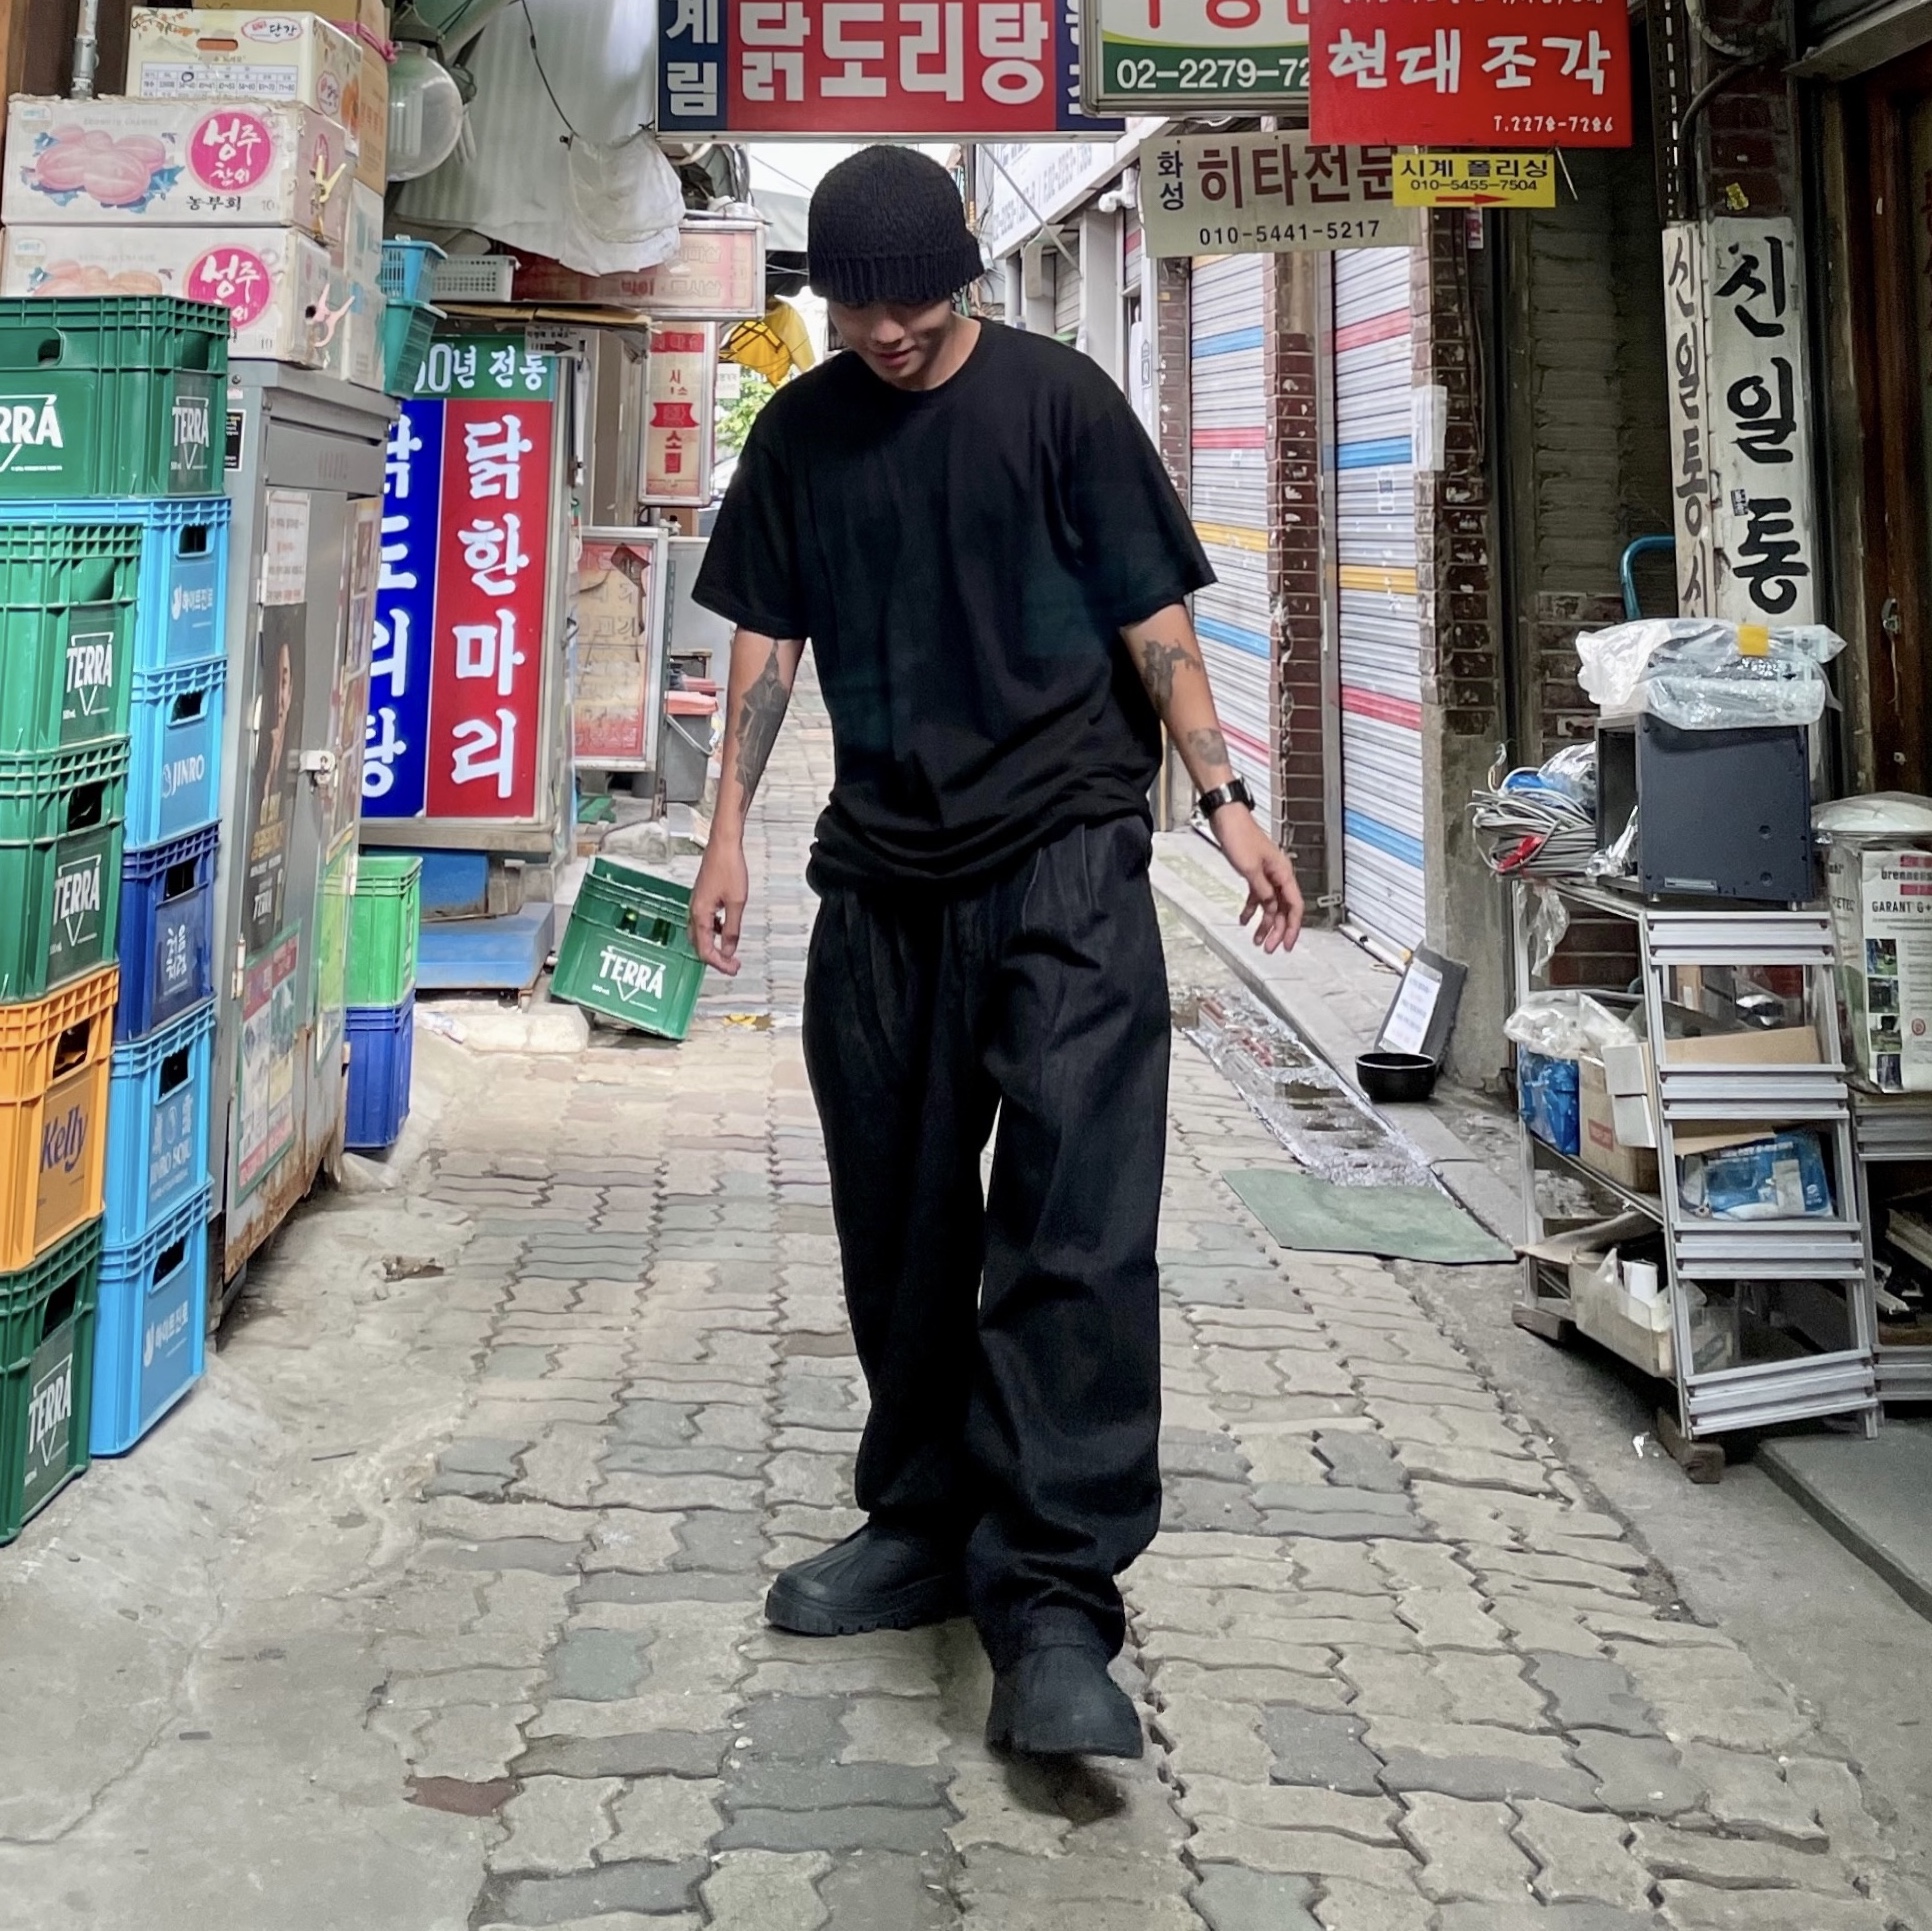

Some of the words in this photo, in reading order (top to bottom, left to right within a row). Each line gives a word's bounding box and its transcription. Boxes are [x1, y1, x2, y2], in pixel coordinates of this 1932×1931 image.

[738, 2, 1049, 105] 닭도리탕
[1328, 28, 1460, 95] 현대
[1481, 29, 1612, 96] 조각
[202, 117, 262, 167] 성주
[211, 163, 250, 187] 참외
[1157, 149, 1185, 212] 화성
[1197, 143, 1394, 209] 히타전문
[1400, 159, 1454, 178] 시계
[1410, 179, 1538, 191] 010-5455-7504
[1199, 220, 1381, 246] 010-5441-5217
[200, 253, 261, 301] 성주
[414, 342, 477, 391] 0년
[172, 405, 209, 448] TERRA
[66, 643, 112, 693] TERRA
[171, 754, 205, 796] JINRO
[53, 866, 100, 926] TERRA
[1872, 901, 1911, 913] GARANT
[600, 948, 663, 999] TERRA
[40, 1104, 88, 1173] Kelly
[28, 1368, 71, 1454] TERRA
